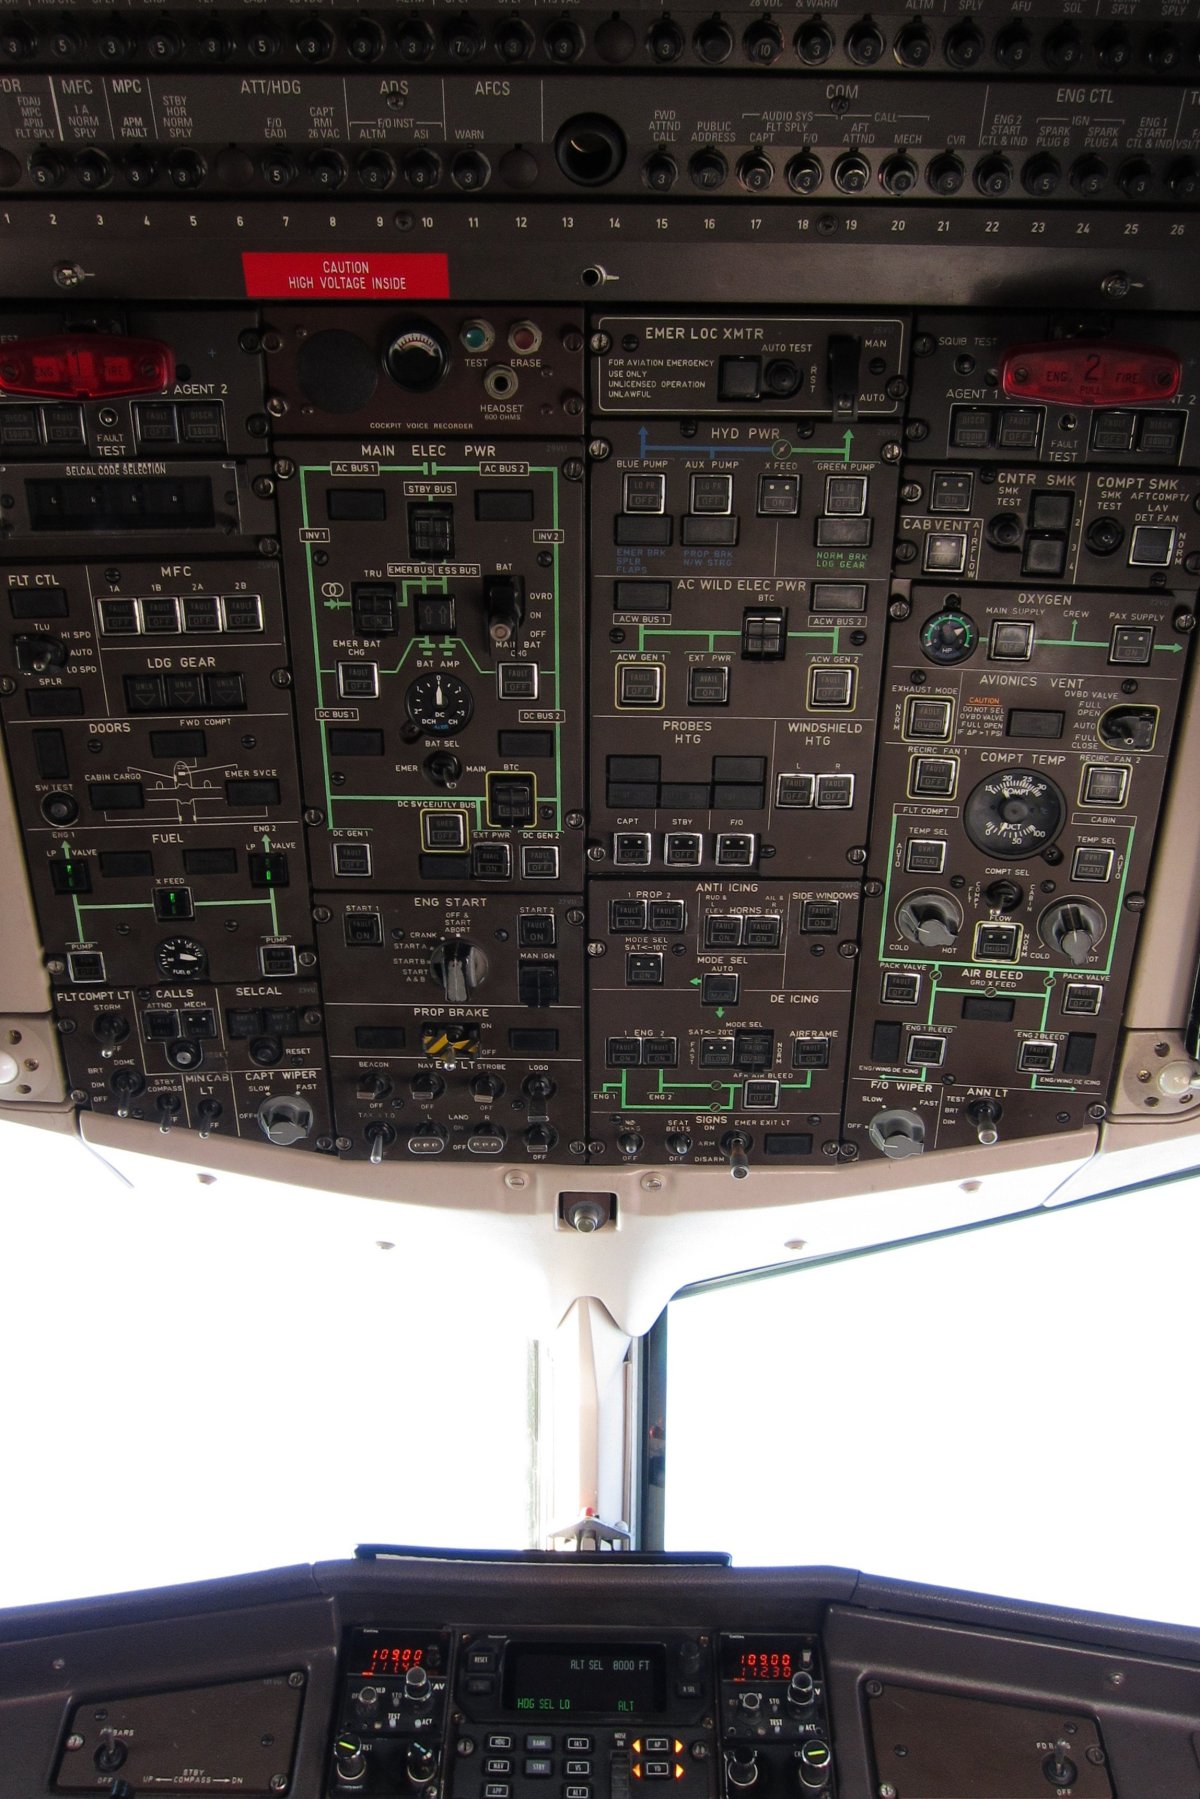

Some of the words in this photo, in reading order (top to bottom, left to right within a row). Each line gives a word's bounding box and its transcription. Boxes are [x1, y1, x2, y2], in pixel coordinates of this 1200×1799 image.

[62, 80, 93, 95] MFC
[112, 80, 142, 94] MPC
[241, 80, 300, 95] ATT/HDG
[474, 82, 511, 96] AFCS
[826, 84, 859, 99] COM
[1057, 88, 1085, 103] ENG
[1089, 88, 1114, 104] CTL
[309, 107, 334, 117] CAPT
[654, 110, 676, 120] FWD
[874, 112, 897, 122] CALL
[123, 117, 143, 127] APM
[313, 118, 333, 128] RMI
[648, 121, 681, 131] ATTND
[697, 121, 731, 131] PUBLIC
[1072, 116, 1090, 126] IGN
[121, 128, 148, 138] FAULT
[455, 130, 484, 140] WARN
[1039, 126, 1071, 137] SPARK
[653, 132, 677, 142] CALL
[691, 132, 736, 142] ADDRESS
[894, 134, 922, 145] MECH
[947, 135, 966, 145] CVR
[1036, 137, 1060, 147] PLUG
[97, 215, 104, 225] 3
[190, 216, 197, 227] 5
[329, 216, 337, 227] 8
[421, 217, 433, 228] 10
[562, 217, 574, 228] 13
[703, 218, 715, 229] 16
[891, 220, 906, 231] 20
[1031, 222, 1045, 233] 23
[1170, 224, 1185, 235] 26
[323, 262, 369, 273] CAUTION
[288, 277, 314, 289] HIGH
[320, 277, 366, 290] VOLTAGE
[372, 278, 407, 290] INSIDE
[645, 328, 685, 340] EMER
[690, 328, 718, 340] LOC
[723, 328, 764, 340] XMTR
[761, 344, 787, 352] AUTO
[789, 344, 812, 352] TEST
[865, 340, 887, 348] MAN
[465, 359, 488, 368] TEST
[510, 359, 541, 368] ERASE
[608, 359, 624, 367] FOR
[626, 359, 664, 367] AVIATION
[666, 359, 715, 367] EMERGENCY
[608, 370, 624, 378] USE
[626, 370, 647, 378] ONLY
[608, 380, 657, 388] UNLICENSED
[661, 380, 706, 388] OPERATION
[174, 384, 215, 395] AGENT
[221, 384, 228, 395] 2
[608, 390, 651, 398] UNLAWFUL
[946, 388, 989, 399] AGENT
[993, 389, 999, 399] 1
[480, 404, 523, 413] HEADSET
[433, 422, 474, 430] RECORDER
[711, 428, 740, 440] HYD
[749, 428, 780, 440] PWR
[97, 446, 126, 456] TEST
[361, 445, 395, 456] MAIN
[411, 445, 446, 456] ELEC
[464, 445, 496, 457] PWR
[616, 460, 640, 468] BLUE
[643, 460, 668, 468] PUMP
[685, 460, 705, 469] AUX
[711, 460, 739, 469] PUMP
[817, 463, 846, 471] GREEN
[850, 463, 876, 471] PUMP
[998, 473, 1036, 485] CNTR
[1046, 474, 1076, 486] SMK
[1096, 476, 1144, 489] COMPT
[1148, 478, 1180, 490] SMK
[408, 485, 431, 494] STBY
[434, 485, 453, 494] BUS
[902, 519, 931, 530] CAB
[935, 520, 971, 531] VENT
[816, 552, 844, 561] NORM
[848, 553, 868, 561] BRK
[496, 563, 513, 571] BAT
[816, 560, 835, 568] LDG
[839, 560, 865, 569] GEAR
[161, 566, 192, 577] MFC
[8, 575, 30, 586] FLT
[35, 575, 60, 586] CTL
[677, 580, 695, 591] AC
[700, 580, 732, 591] WILD
[737, 581, 770, 591] ELEC
[776, 581, 806, 592] PWR
[1018, 593, 1072, 606] OXYGEN
[986, 607, 1009, 615] MAIN
[1012, 607, 1046, 616] SUPPLY
[70, 649, 93, 657] AUTO
[147, 658, 172, 669] LDG
[180, 657, 216, 668] GEAR
[979, 674, 1038, 687] AVIONICS
[1050, 677, 1085, 689] VENT
[89, 723, 131, 734] DOORS
[662, 721, 712, 732] PROBES
[788, 722, 863, 734] WINDSHIELD
[424, 740, 442, 748] BAT
[444, 740, 460, 748] SEL
[675, 734, 701, 745] HTG
[805, 735, 831, 746] HTG
[980, 752, 1024, 764] COMPT
[1031, 754, 1067, 766] TEMP
[672, 818, 693, 826] STBY
[152, 833, 184, 844] FUEL
[696, 883, 724, 893] ANTI
[728, 883, 759, 893] ICING
[792, 892, 813, 900] SIDE
[816, 892, 859, 900] WINDOWS
[414, 898, 439, 907] ENG
[445, 898, 487, 907] START
[730, 906, 762, 914] HORNS
[961, 969, 983, 980] AIR
[985, 969, 1023, 981] BLEED
[57, 992, 76, 1001] FLT
[78, 991, 110, 1000] COMPT
[114, 991, 130, 1000] LT
[155, 988, 194, 999] CALLS
[236, 986, 282, 996] SELCAL
[770, 995, 786, 1003] DE
[790, 995, 819, 1004] ICING
[413, 1008, 445, 1017] PROP
[449, 1008, 490, 1018] BRAKE
[790, 1030, 839, 1038] AIRFRAME
[245, 1072, 274, 1081] CAPT
[282, 1071, 317, 1080] WIPER
[896, 1082, 933, 1093] WIPER
[967, 1087, 993, 1097] ANN
[994, 1088, 1009, 1098] LT
[696, 1115, 727, 1124] SIGNS
[570, 1660, 585, 1670] ALT
[588, 1660, 603, 1670] SEL
[613, 1660, 635, 1671] 8000
[638, 1661, 650, 1671] FT
[539, 1698, 555, 1709] SEL
[617, 1701, 635, 1711] ALT
